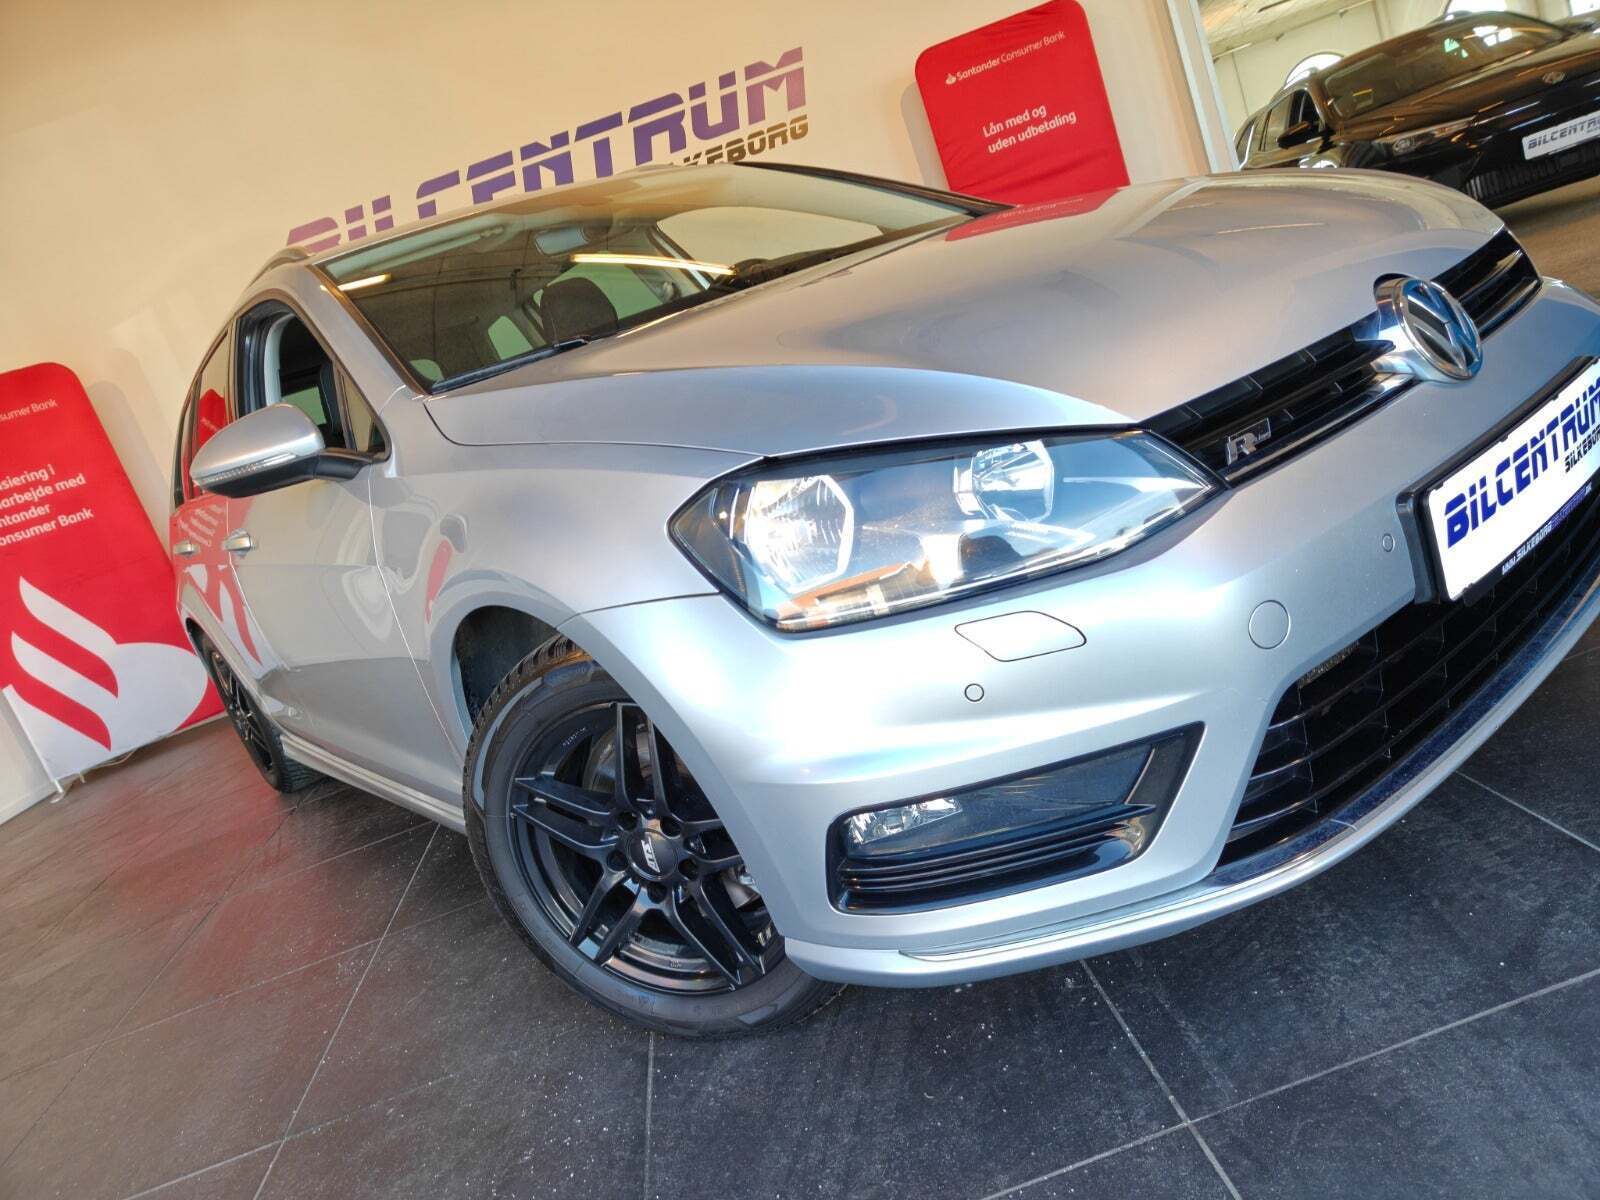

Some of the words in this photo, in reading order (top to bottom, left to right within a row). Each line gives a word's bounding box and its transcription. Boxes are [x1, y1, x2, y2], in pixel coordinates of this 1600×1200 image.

[956, 57, 1000, 81] Santander
[1000, 39, 1043, 63] Consumer
[1043, 31, 1066, 46] Bank
[982, 122, 1004, 138] Lån
[1005, 109, 1030, 129] med
[1031, 105, 1047, 119] og
[988, 135, 1016, 154] uden
[1017, 111, 1077, 142] udbetaling
[1527, 116, 1600, 150] BILCENTR
[31, 399, 58, 413] Bank
[48, 463, 56, 475] i
[0, 484, 54, 510] arbejde
[55, 473, 86, 492] med
[57, 507, 94, 527] Bank
